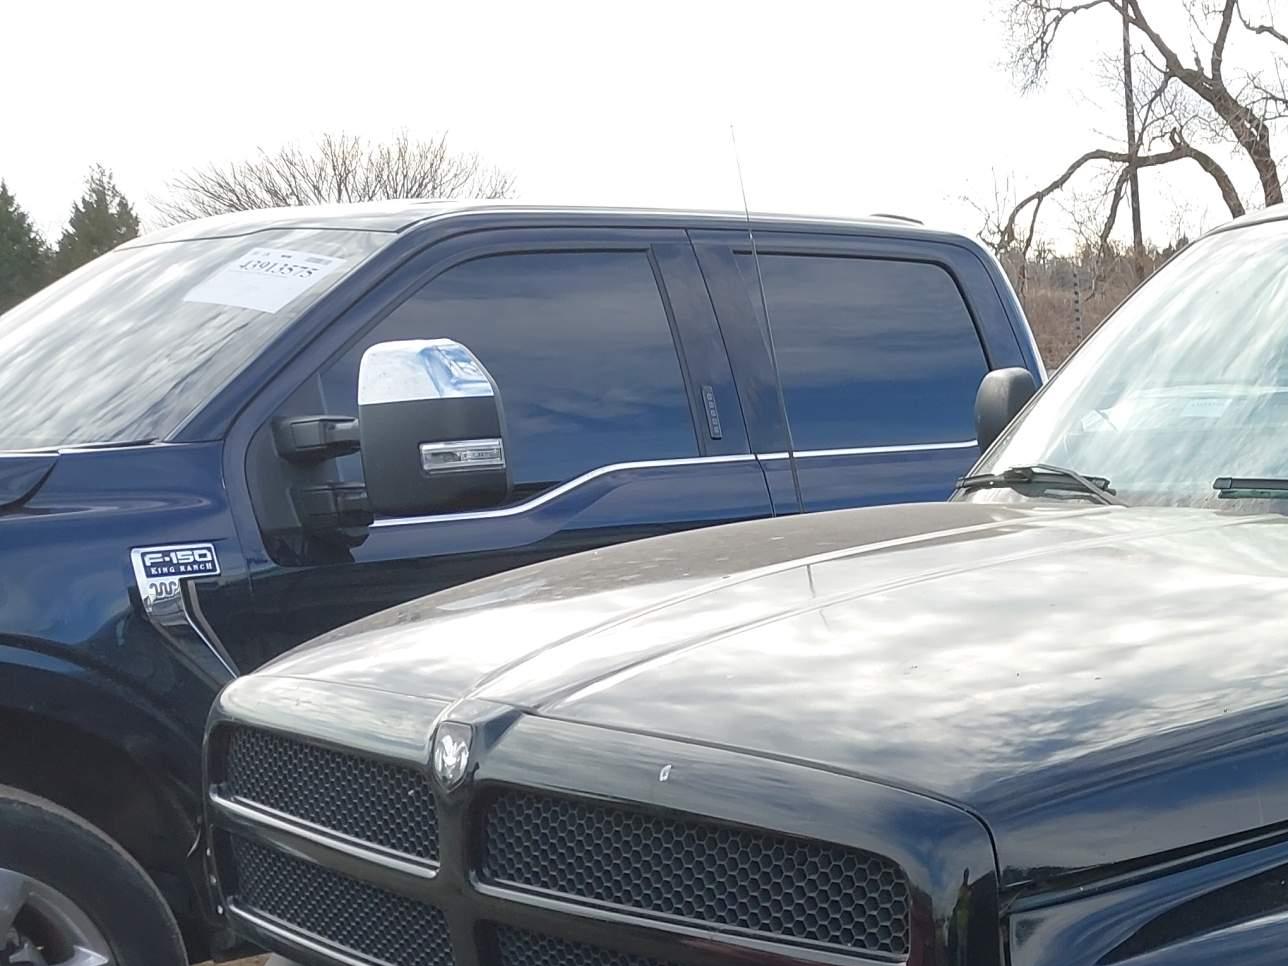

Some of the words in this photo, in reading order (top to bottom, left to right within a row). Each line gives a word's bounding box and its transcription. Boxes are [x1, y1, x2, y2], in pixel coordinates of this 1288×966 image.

[143, 549, 213, 567] F-150
[150, 566, 176, 575] KING
[179, 562, 213, 572] RANCH
